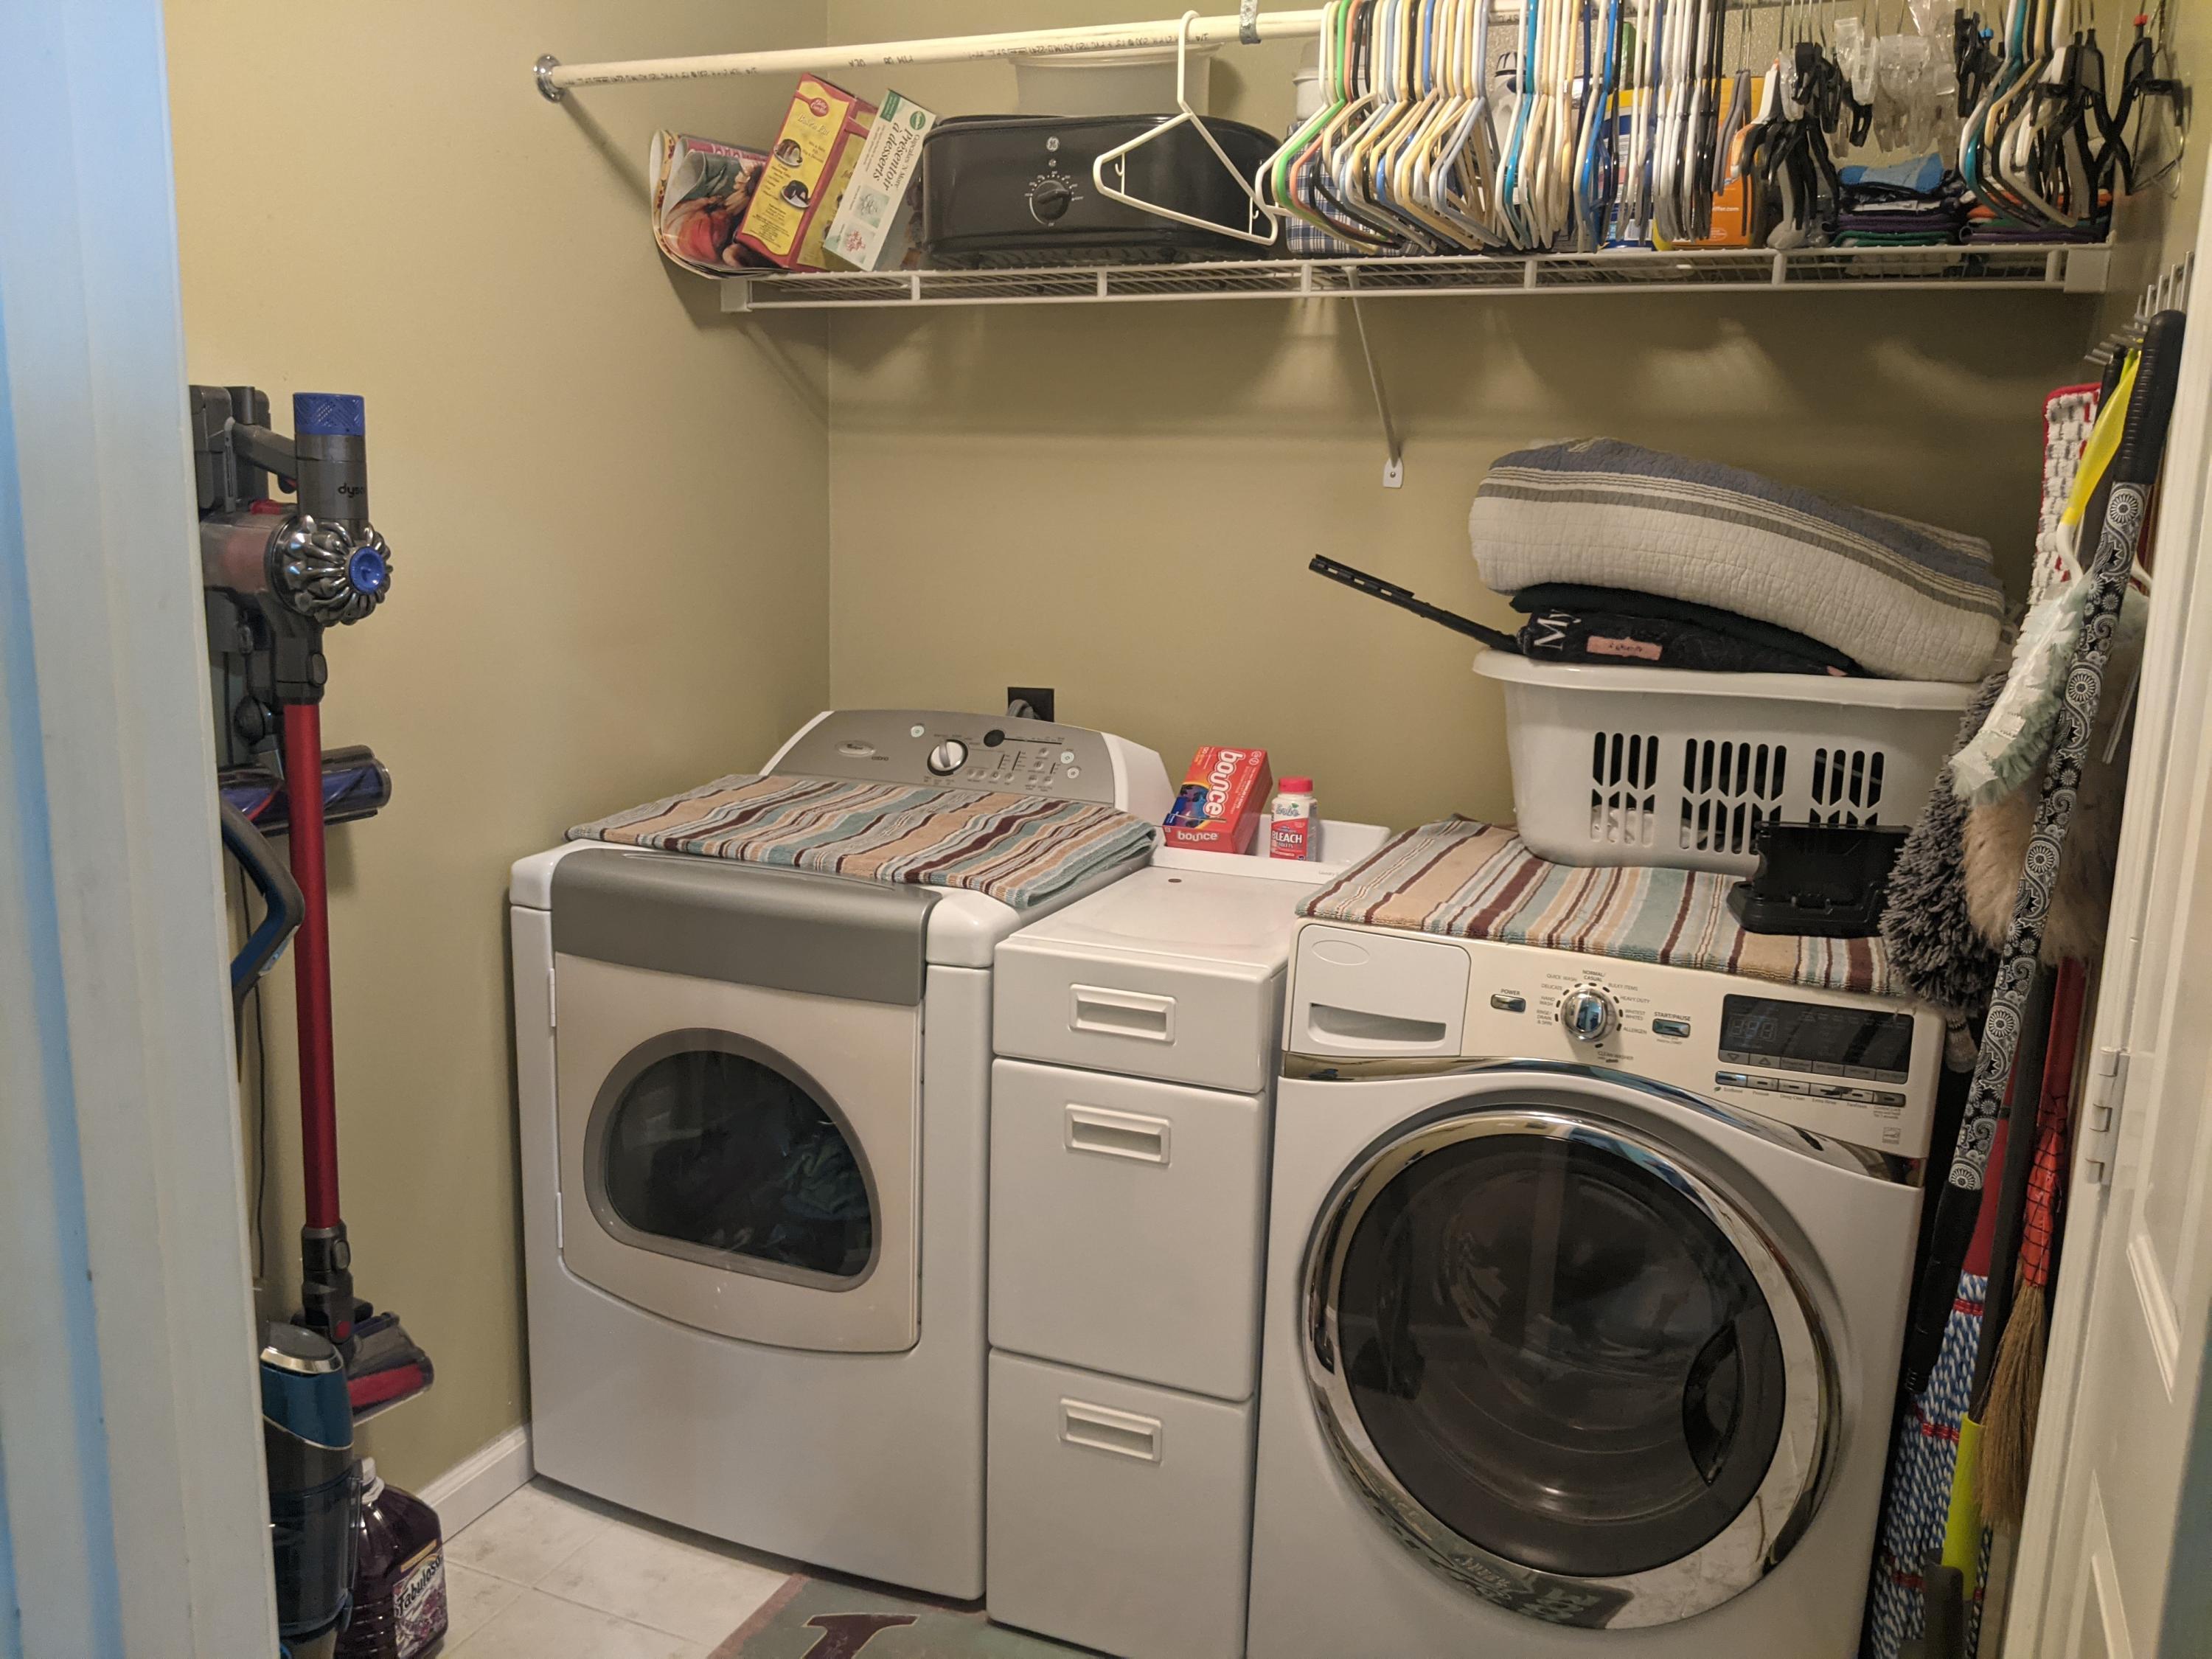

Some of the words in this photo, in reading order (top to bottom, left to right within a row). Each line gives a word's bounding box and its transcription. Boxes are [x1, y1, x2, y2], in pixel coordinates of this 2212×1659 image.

[892, 122, 902, 133] à
[872, 133, 898, 181] desserts
[883, 128, 914, 191] Présentoir
[1204, 750, 1245, 817] bounce
[1178, 830, 1218, 841] bounce
[1271, 830, 1303, 844] BLEACH
[1583, 975, 1603, 983] CASUAL
[1500, 988, 1520, 996] POWER
[1654, 1011, 1691, 1022] START/PAUSE
